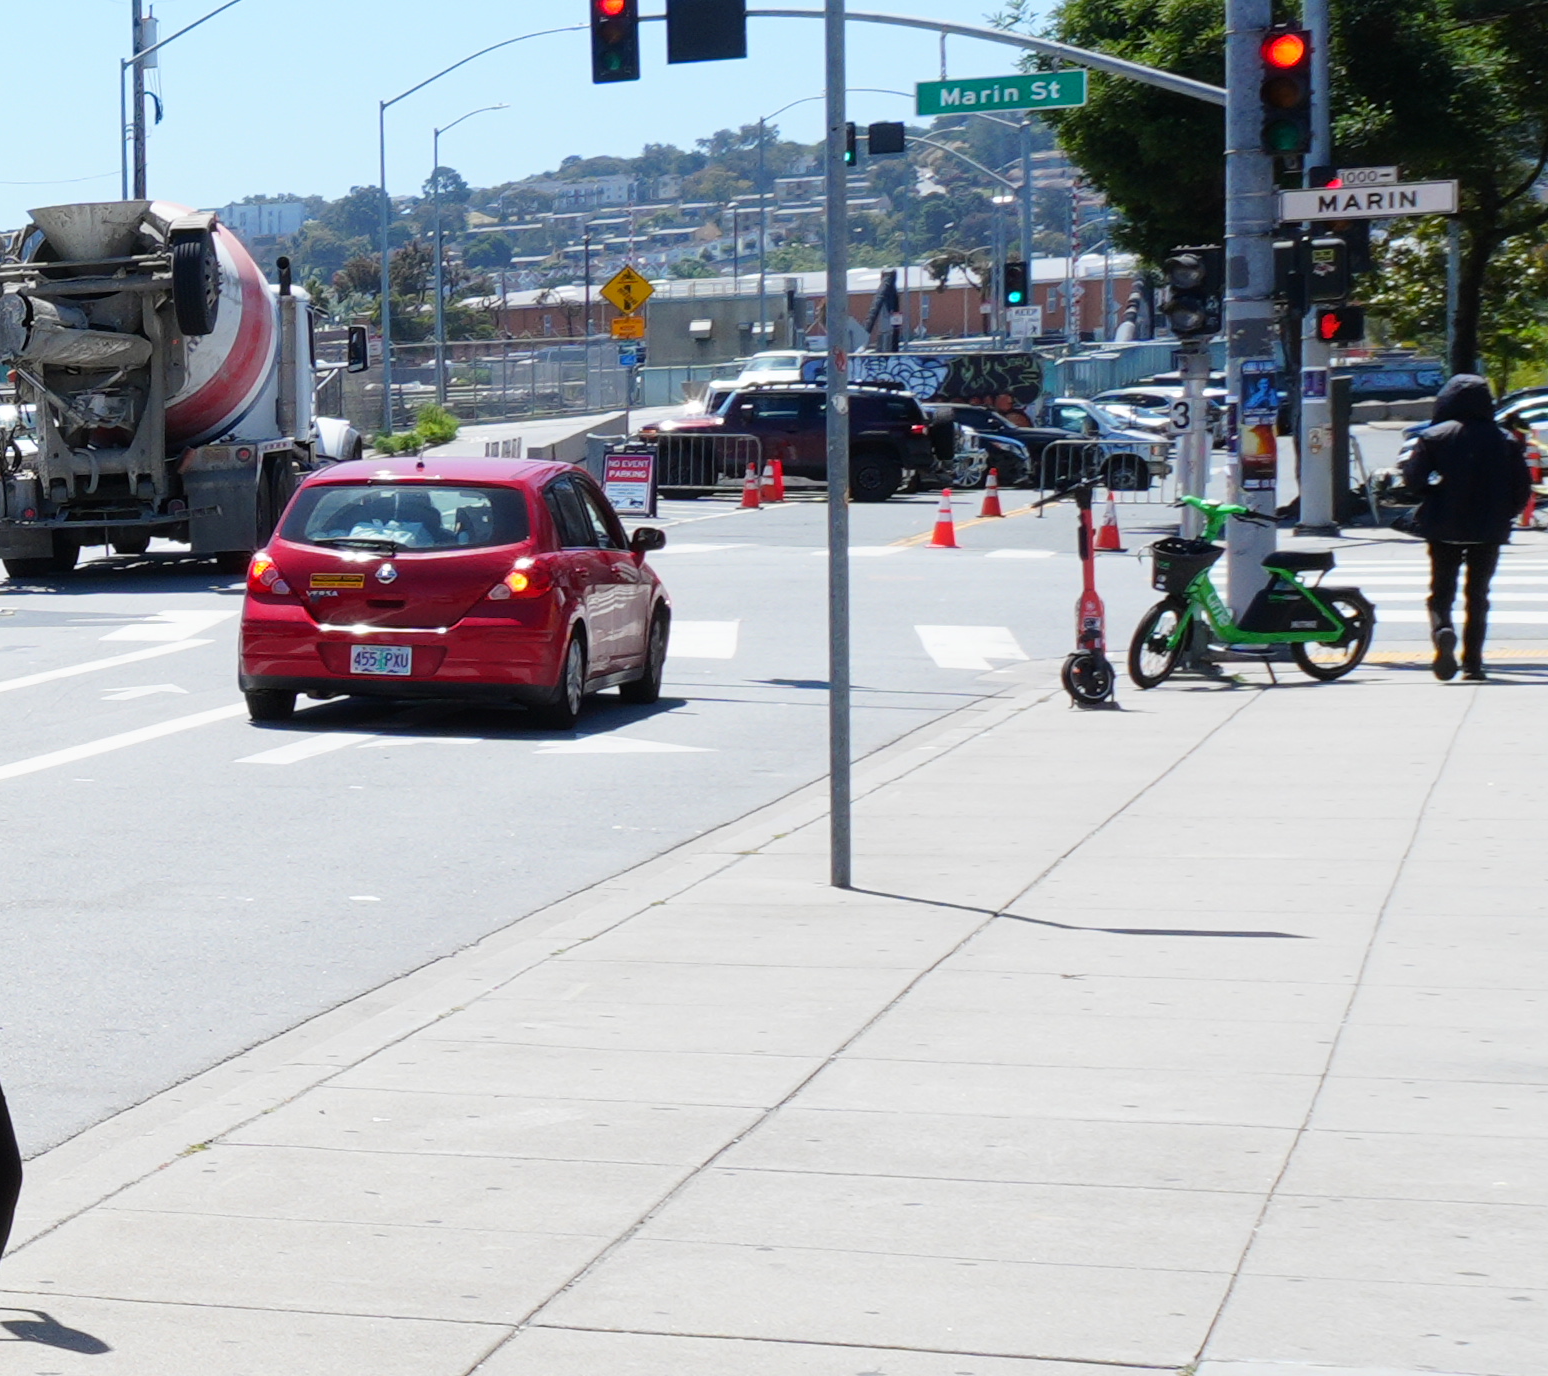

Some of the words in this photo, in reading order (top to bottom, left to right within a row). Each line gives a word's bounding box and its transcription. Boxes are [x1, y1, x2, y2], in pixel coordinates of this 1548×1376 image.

[940, 85, 1020, 107] Marin
[1031, 80, 1061, 101] St
[1318, 190, 1418, 213] MARIN
[1172, 401, 1190, 429] 3
[608, 459, 621, 468] NO
[622, 460, 649, 468] EVENT
[608, 469, 647, 478] PARKING
[354, 651, 377, 667] 455
[385, 652, 409, 668] PXU
